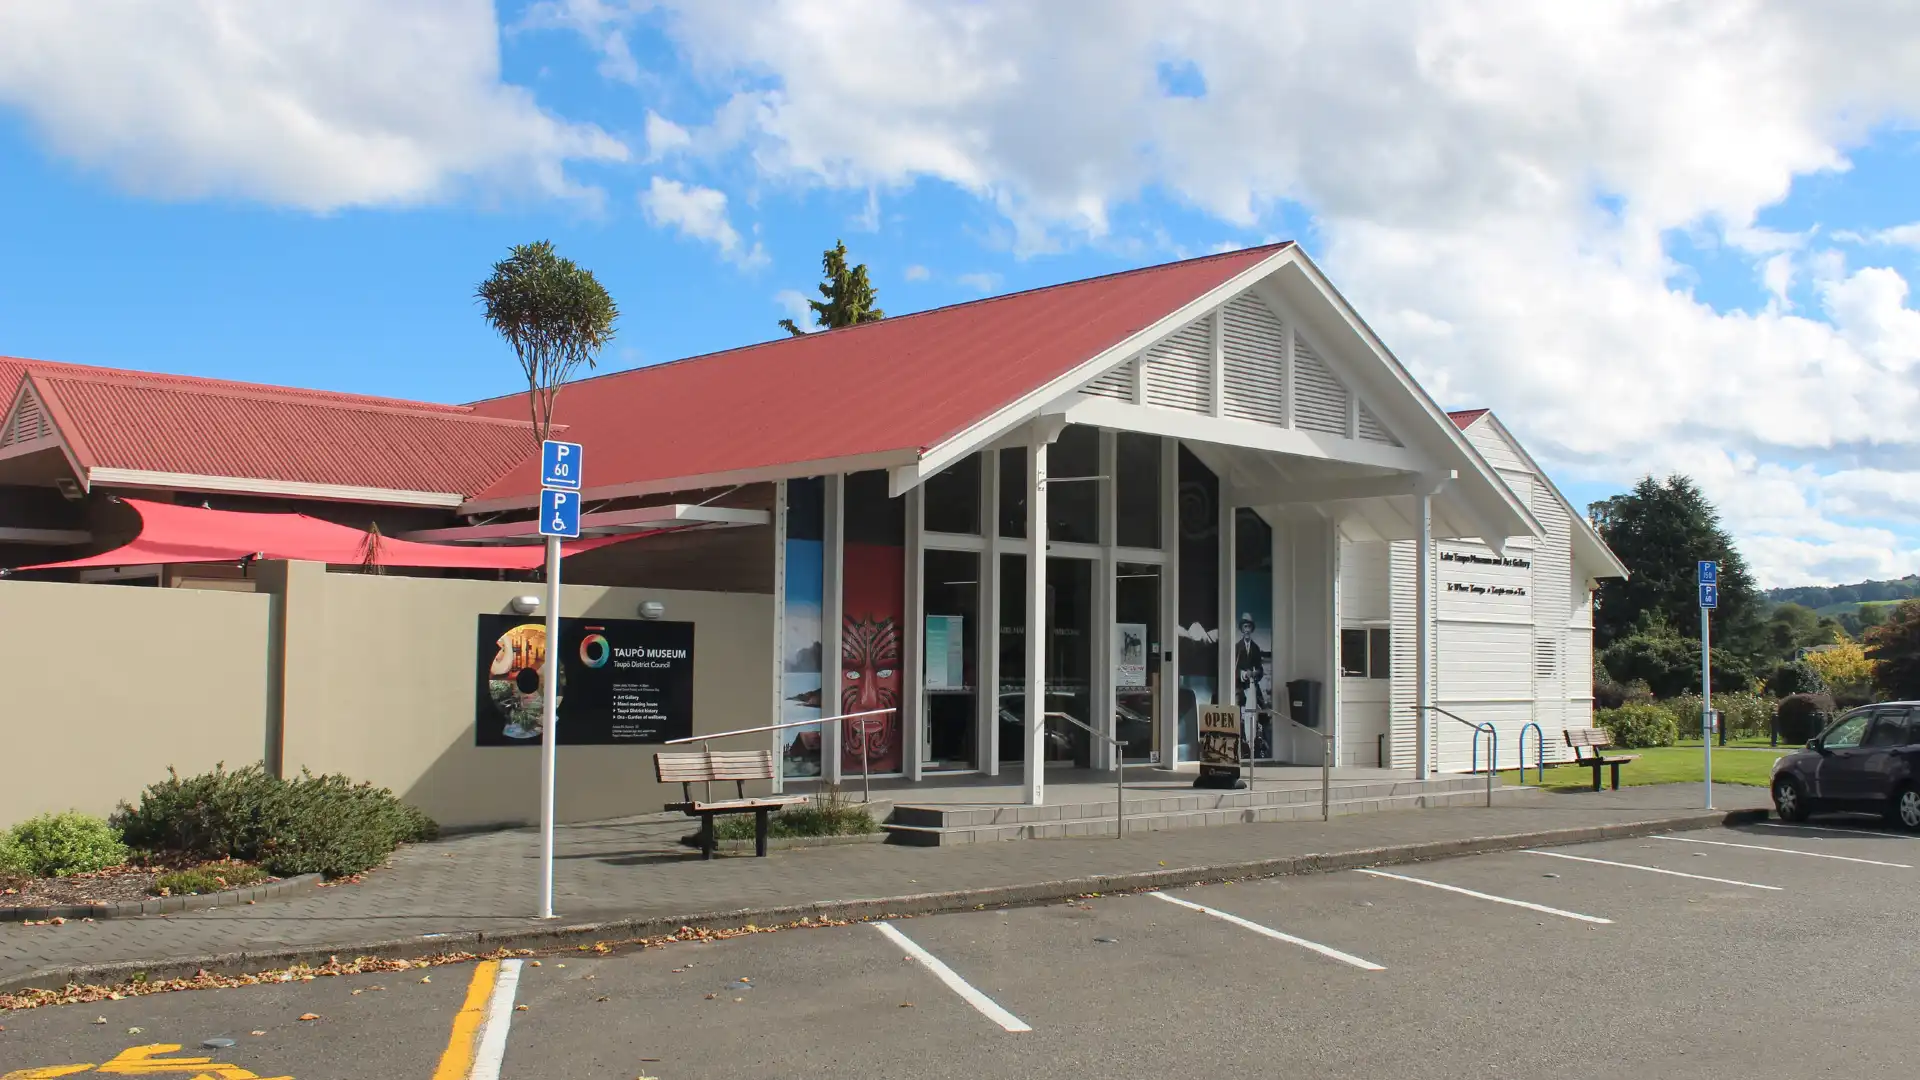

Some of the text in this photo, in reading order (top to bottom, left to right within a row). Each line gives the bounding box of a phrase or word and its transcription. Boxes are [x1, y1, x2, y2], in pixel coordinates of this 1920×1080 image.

[558, 445, 569, 461] P
[554, 463, 569, 476] 60
[554, 493, 566, 509] P
[1440, 551, 1453, 561] Lake
[1470, 554, 1492, 564] Museum
[1492, 557, 1502, 566] and
[1503, 558, 1512, 566] Art
[1512, 559, 1530, 569] Gallery
[1704, 563, 1710, 571] P
[1706, 586, 1712, 595] P
[614, 646, 686, 658] TAUPŌ MUSEUM
[1205, 712, 1234, 728] OPEN
